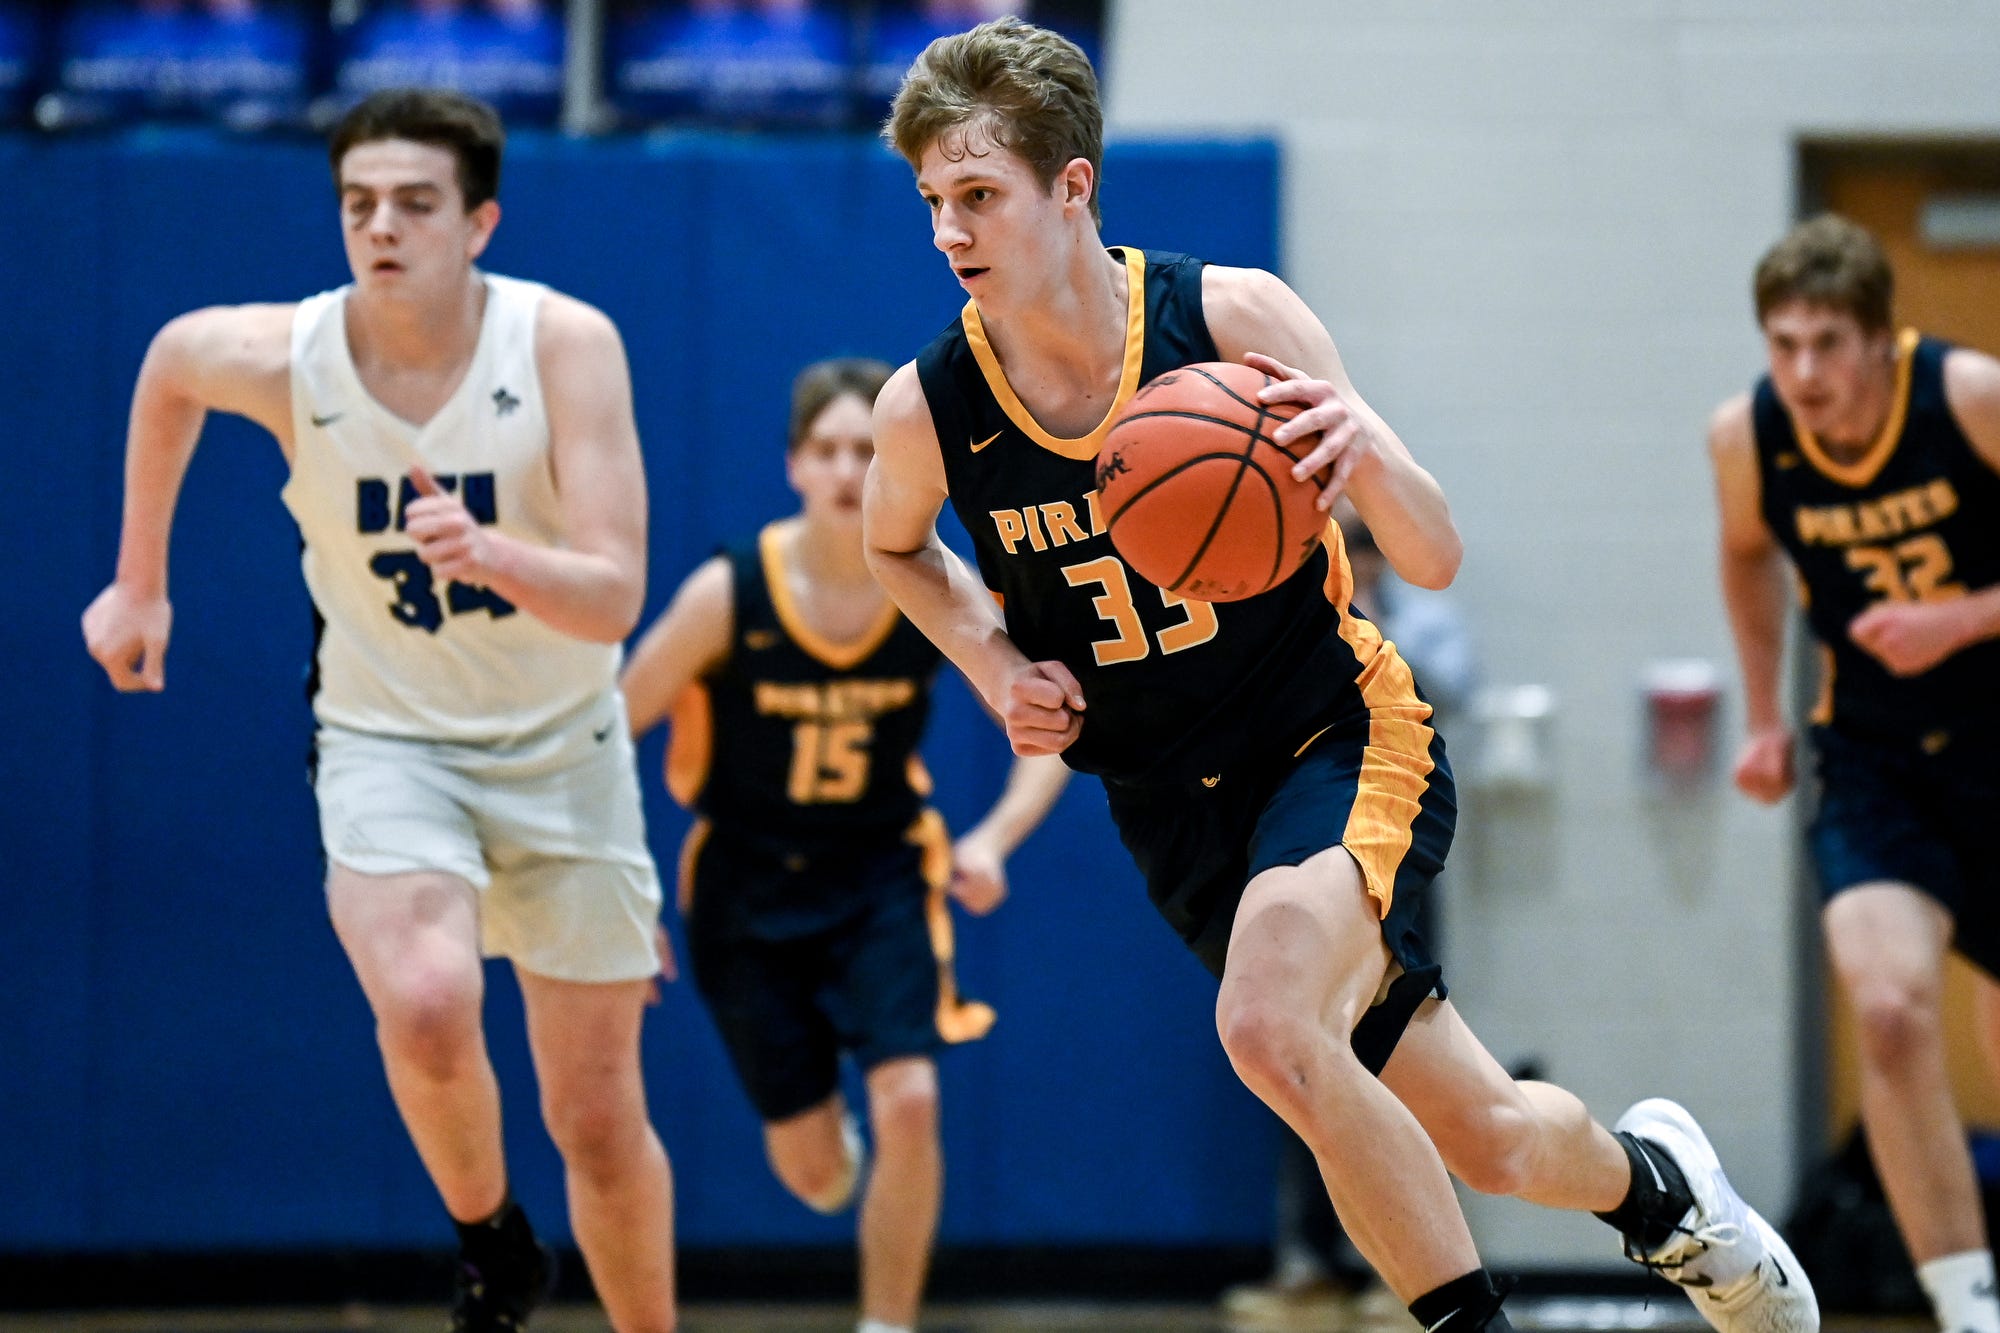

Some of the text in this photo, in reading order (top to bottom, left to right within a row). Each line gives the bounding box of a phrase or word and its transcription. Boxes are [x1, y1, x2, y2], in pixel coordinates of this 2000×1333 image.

[1846, 534, 1967, 604] 32
[1061, 555, 1219, 667] 33
[789, 722, 872, 803] 15
